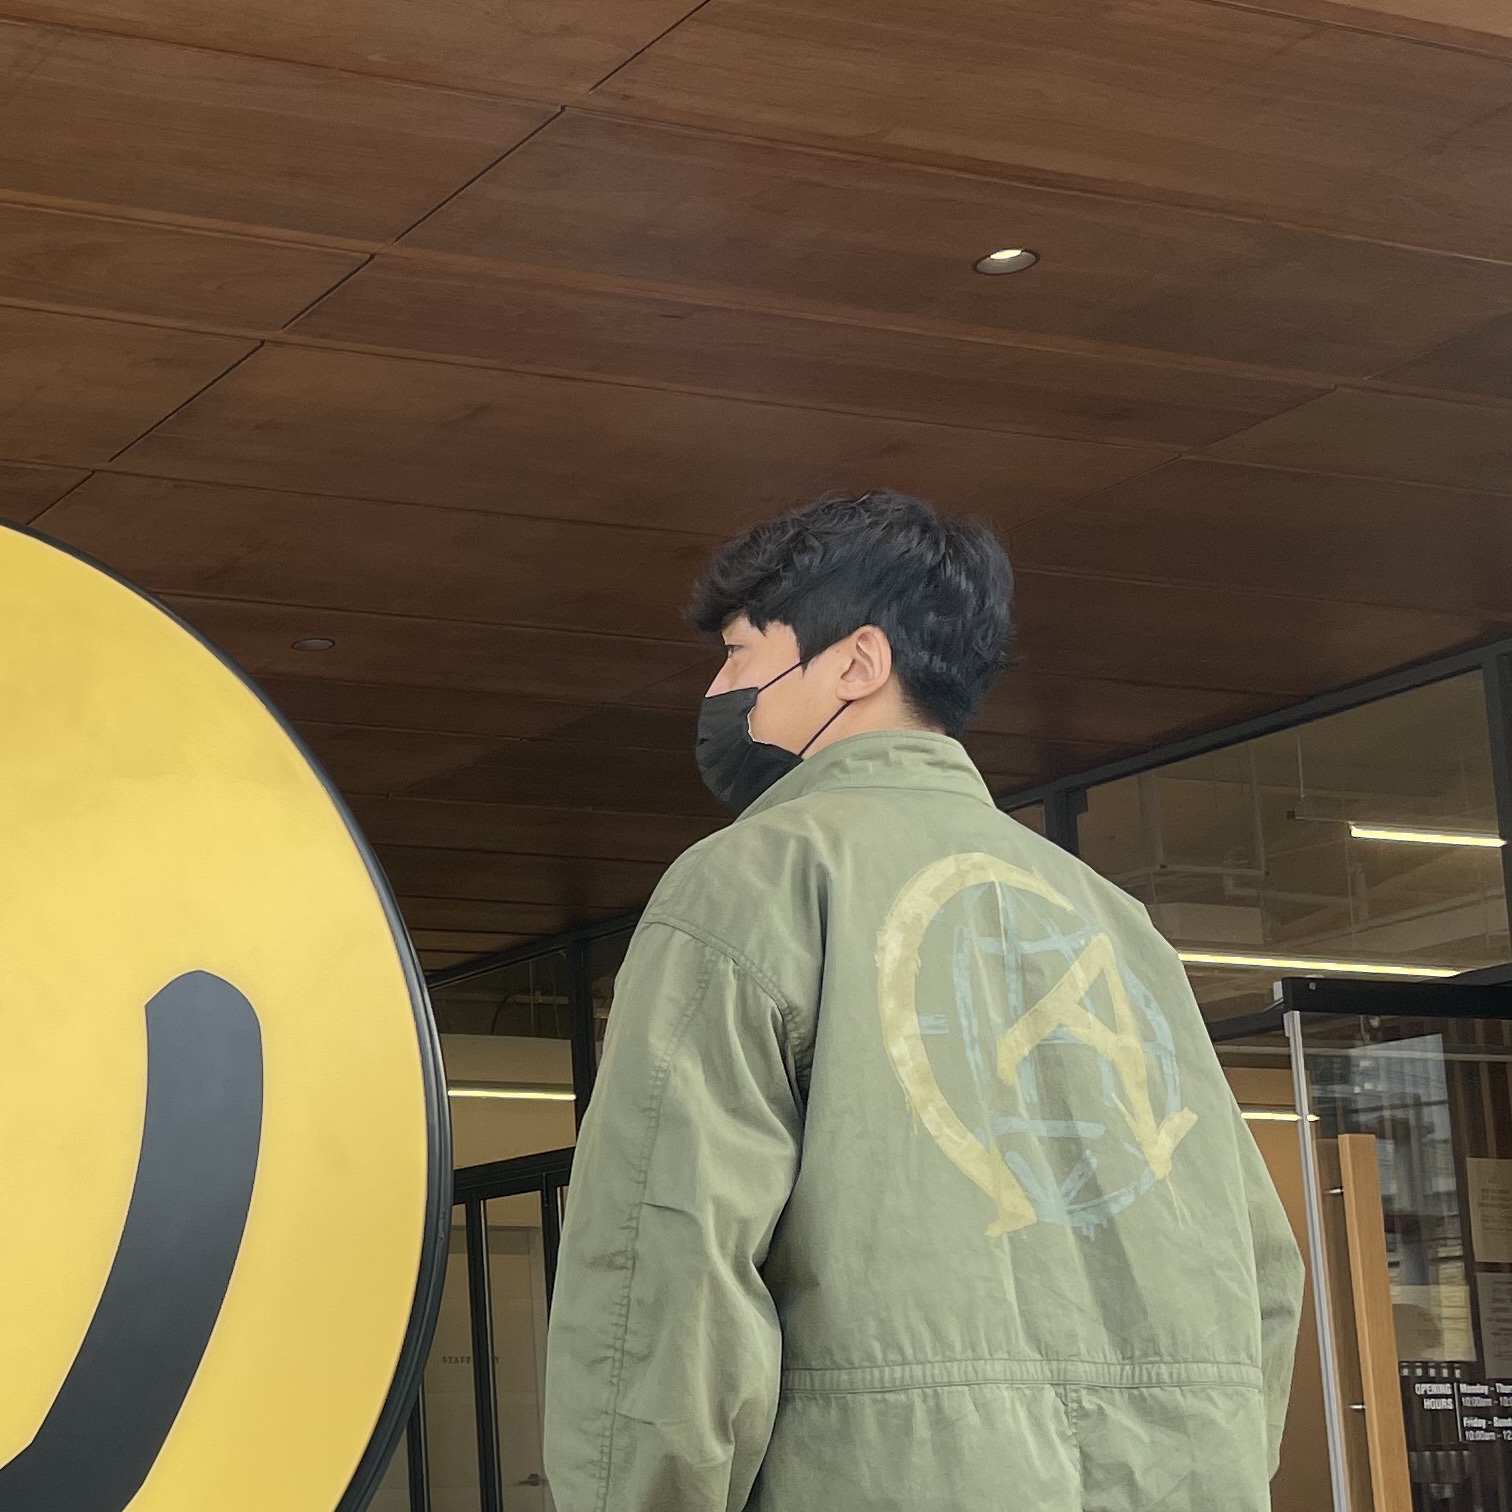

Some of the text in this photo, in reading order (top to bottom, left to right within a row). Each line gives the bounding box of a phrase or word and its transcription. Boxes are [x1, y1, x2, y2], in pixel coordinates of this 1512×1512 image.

[442, 1355, 472, 1365] STAFF
[1414, 1383, 1453, 1395] OPENING
[1459, 1383, 1489, 1395] Monday
[1423, 1398, 1454, 1410] HOURS
